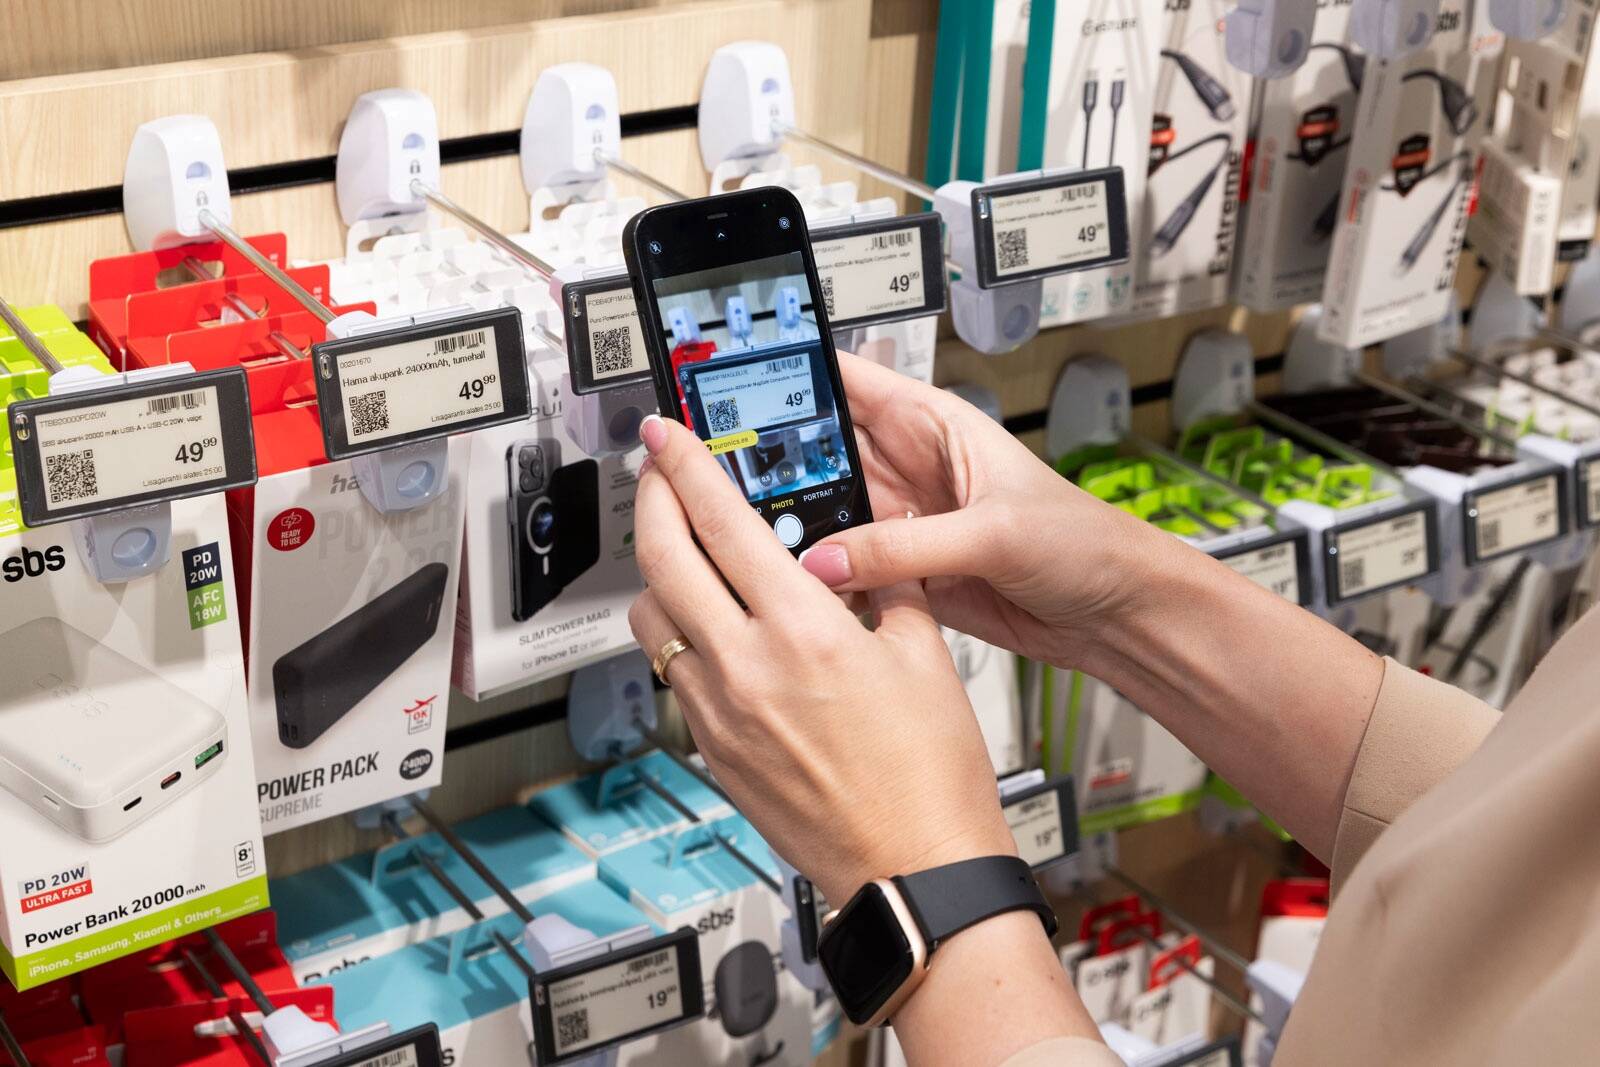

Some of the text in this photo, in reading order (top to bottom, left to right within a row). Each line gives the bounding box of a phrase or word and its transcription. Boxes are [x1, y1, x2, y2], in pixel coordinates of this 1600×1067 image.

[343, 376, 368, 387] Hama
[370, 368, 403, 382] akupank
[453, 350, 485, 365] tumehall
[714, 438, 749, 450] euronics.ee
[771, 498, 794, 511] PHOTO
[803, 488, 834, 501] PORTRAIT
[280, 536, 301, 547] TO USE
[281, 528, 301, 540] READY
[2, 545, 66, 583] sbs
[192, 551, 212, 567] PD
[190, 566, 218, 584] 20W
[193, 589, 220, 609] AFC
[195, 604, 222, 622] 18W
[519, 608, 611, 646] SLIM POWER MAG
[522, 660, 533, 671] for
[535, 649, 567, 667] iPhone
[569, 645, 578, 655] 12
[257, 751, 380, 804] POWER PACK
[260, 792, 323, 825] SUPREME
[24, 866, 86, 894] PD 20W
[25, 884, 88, 910] ULTRA FAST
[24, 922, 82, 948] Power
[85, 904, 129, 929] Bank
[185, 883, 206, 895] mAh
[698, 908, 735, 936] sbs
[29, 958, 73, 978] iPhone,
[75, 936, 132, 963] Samsung,
[133, 922, 171, 943] Xiaomi
[173, 917, 183, 929] &
[184, 905, 222, 925] Others
[647, 985, 677, 1010] 19
